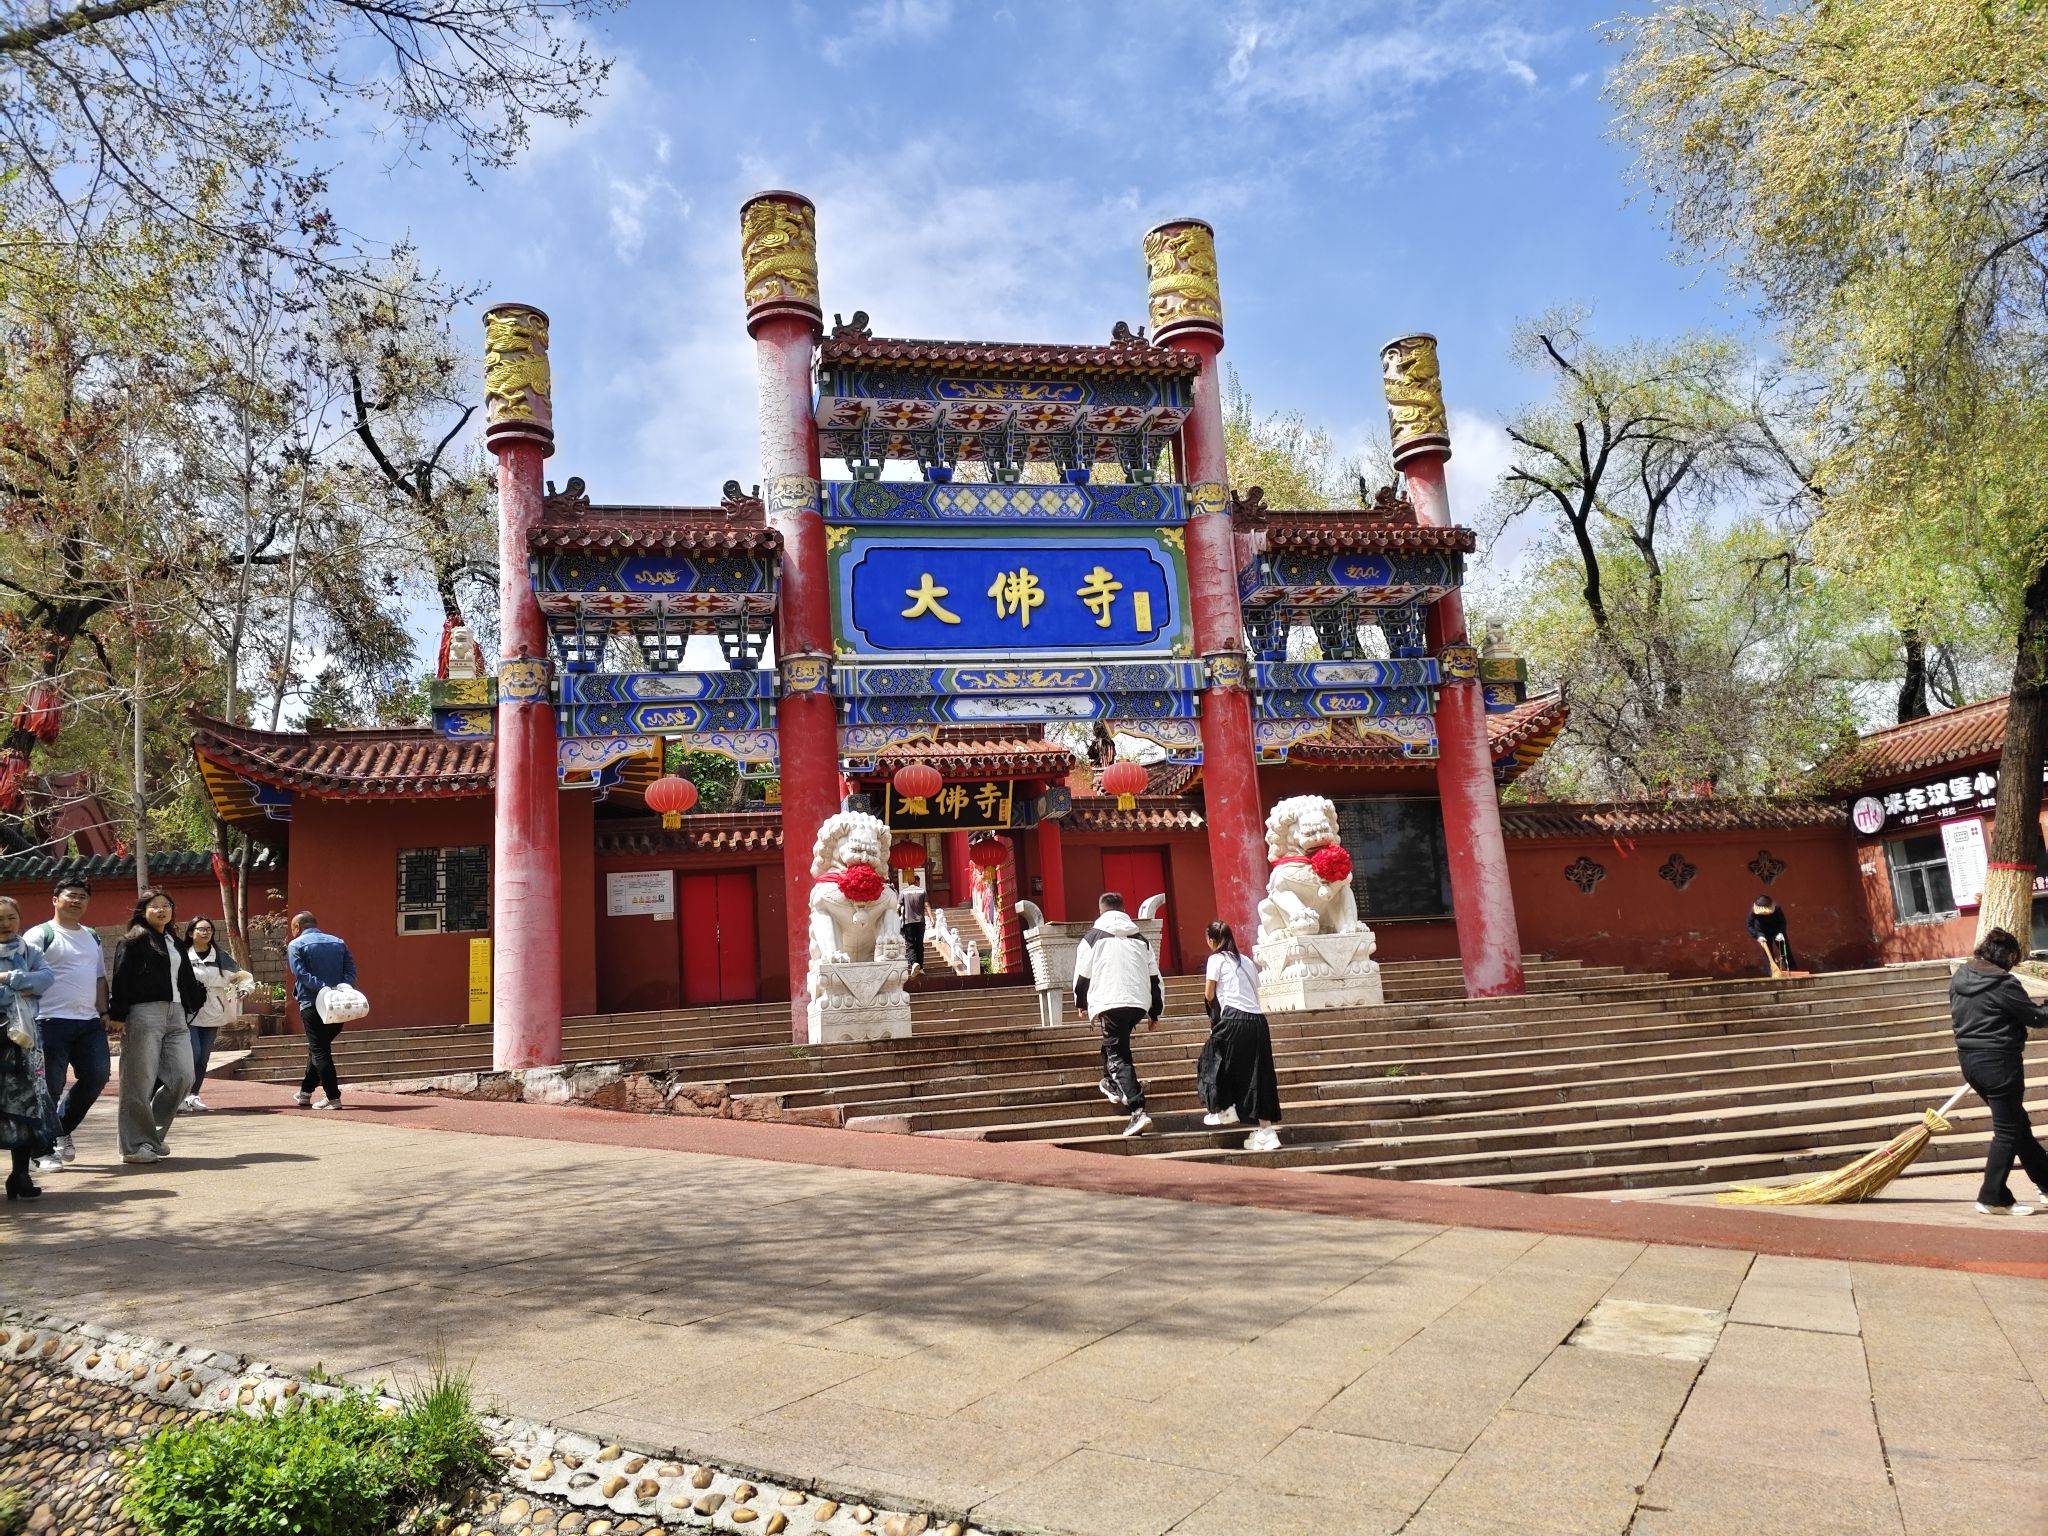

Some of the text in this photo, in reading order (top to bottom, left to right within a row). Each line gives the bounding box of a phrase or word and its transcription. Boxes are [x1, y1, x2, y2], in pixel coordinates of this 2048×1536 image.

[902, 566, 1123, 628] 大佛寺
[1884, 771, 2000, 815] 米克汉堡小
